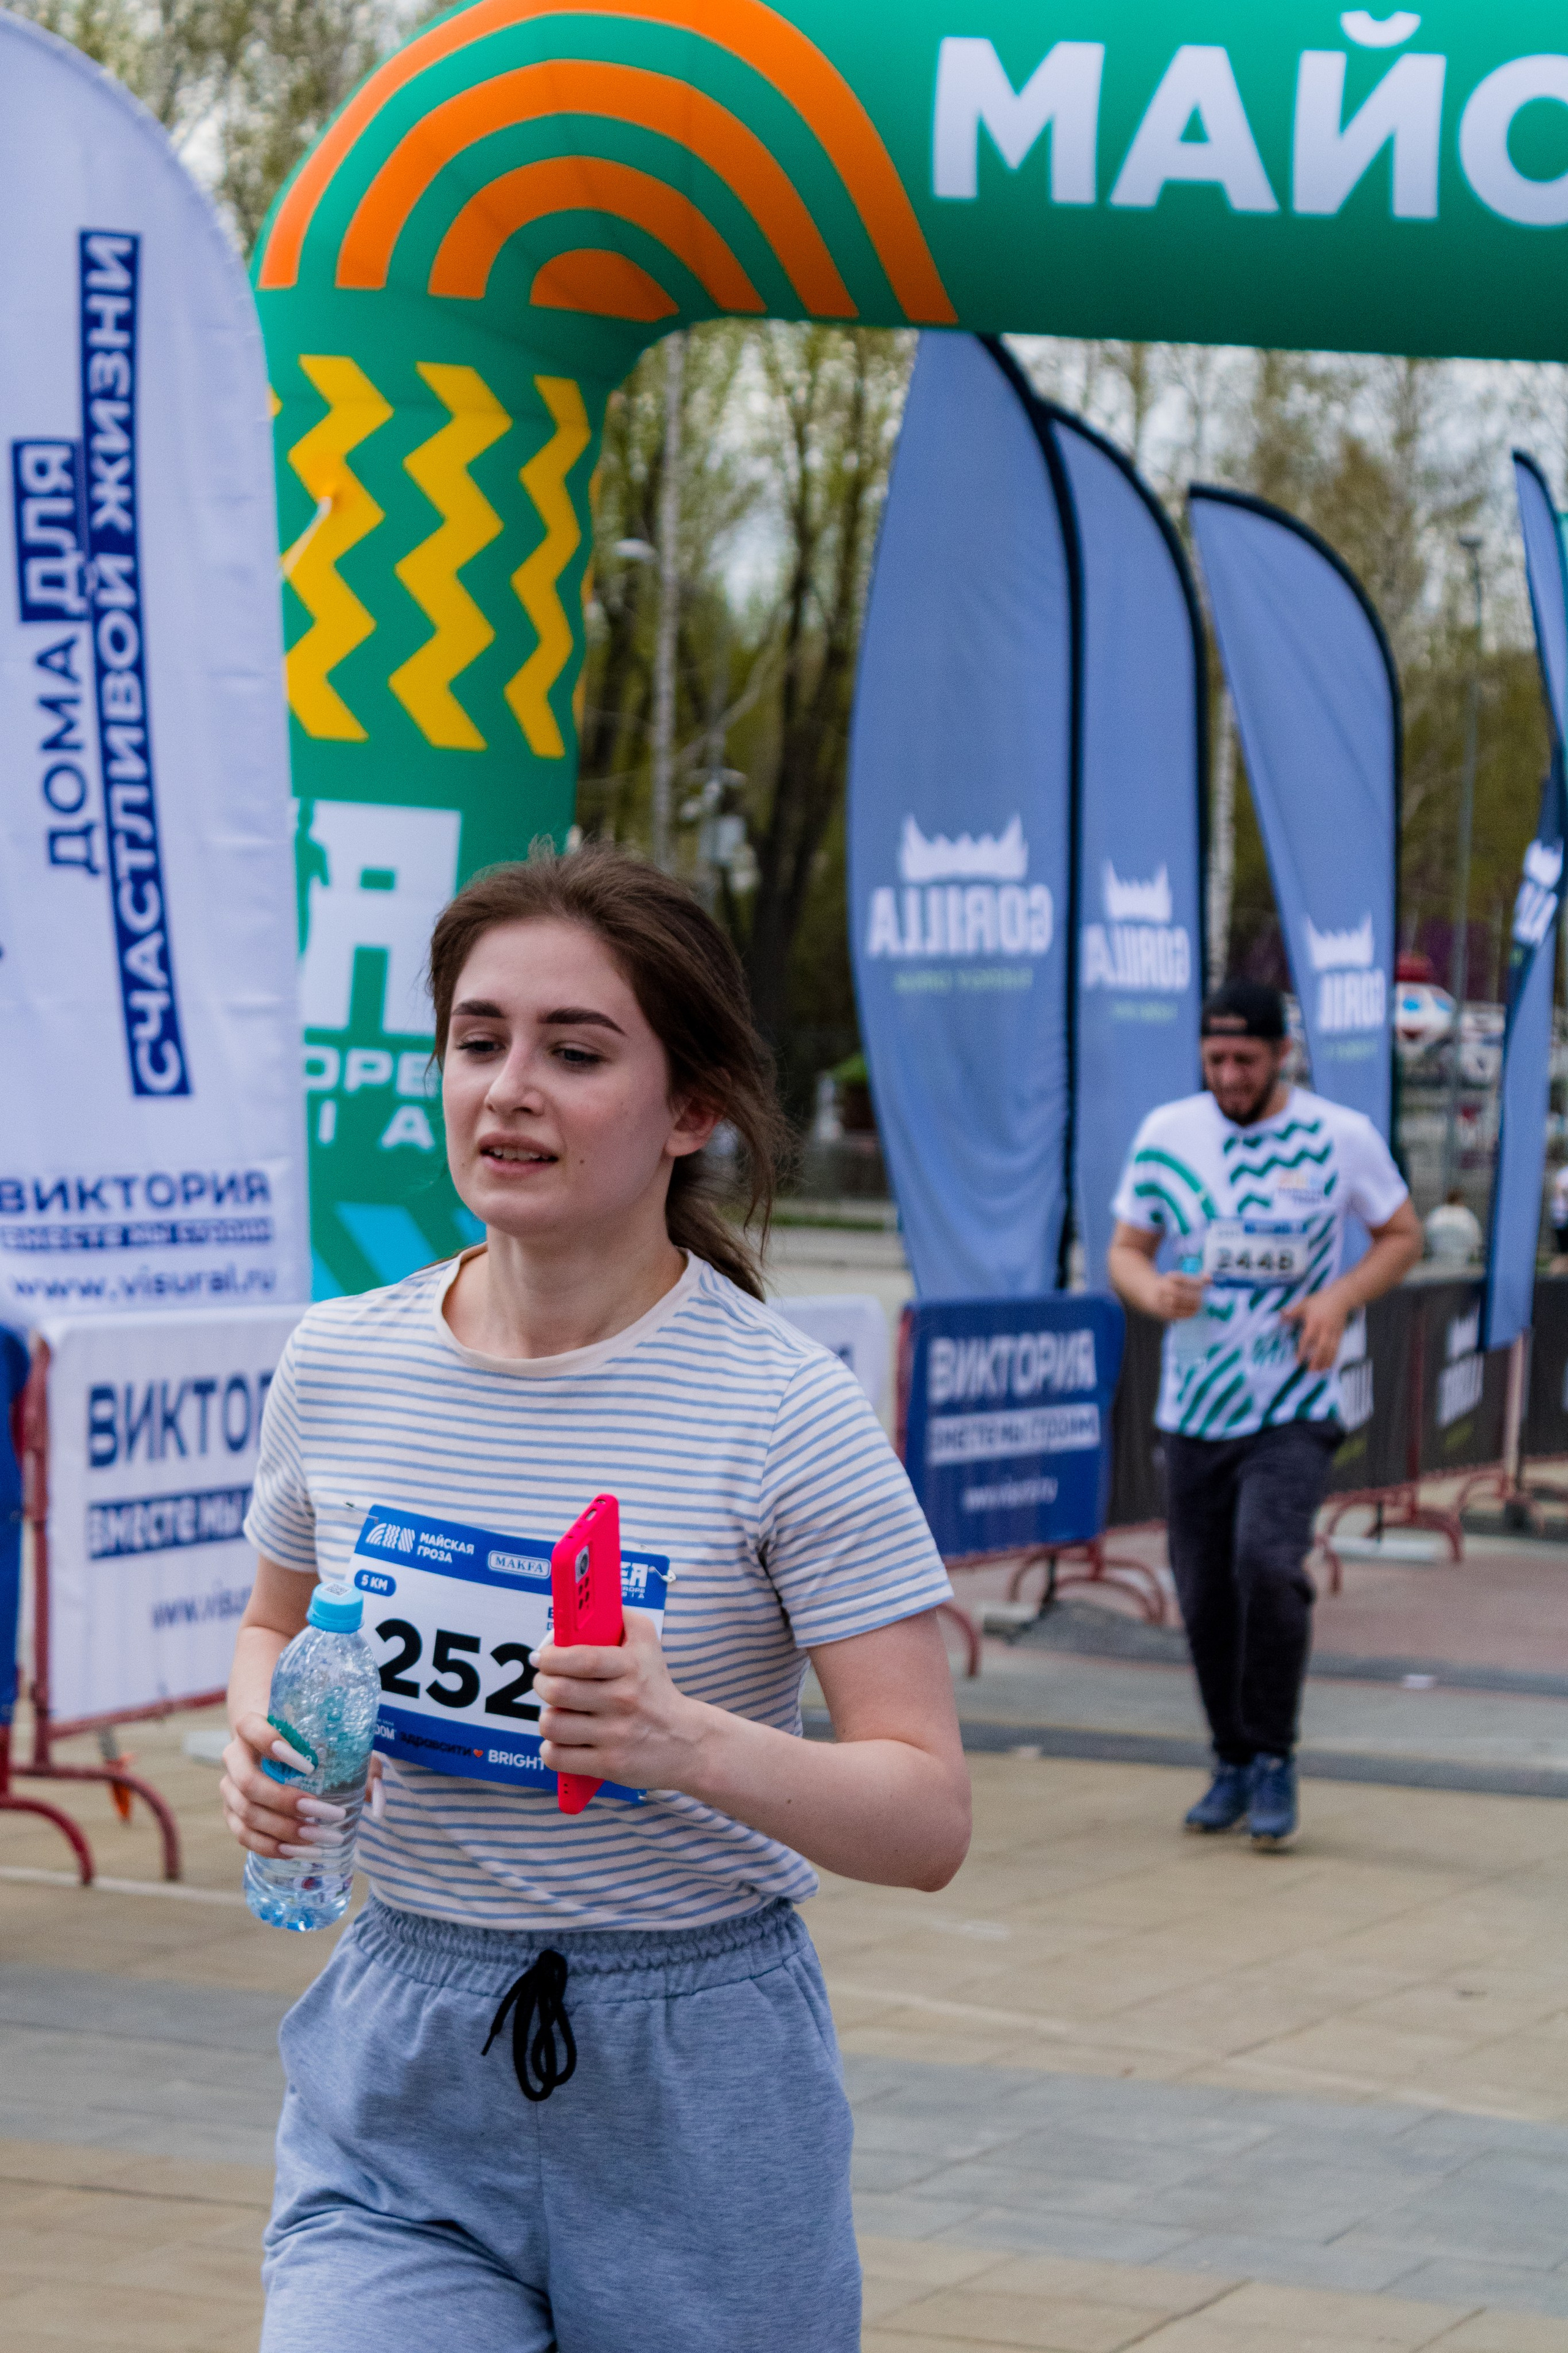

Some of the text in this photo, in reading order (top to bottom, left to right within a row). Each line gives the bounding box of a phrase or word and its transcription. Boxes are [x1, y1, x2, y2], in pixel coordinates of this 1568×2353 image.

[932, 10, 1568, 227] МАЙС
[20, 445, 100, 875] ДОМА ДЛЯ
[85, 233, 183, 1095] СЧАСТЛИВОЙ ЖИЗНИ
[305, 1044, 437, 1098] OPE
[0, 1169, 271, 1214] ВИКТОРИЯ
[417, 1544, 453, 1563] ГРОЗА
[420, 1532, 475, 1555] МАЙСКАЯ
[495, 1556, 544, 1573] MAKFA
[361, 1574, 369, 1585] 5
[374, 1618, 541, 1722] 252
